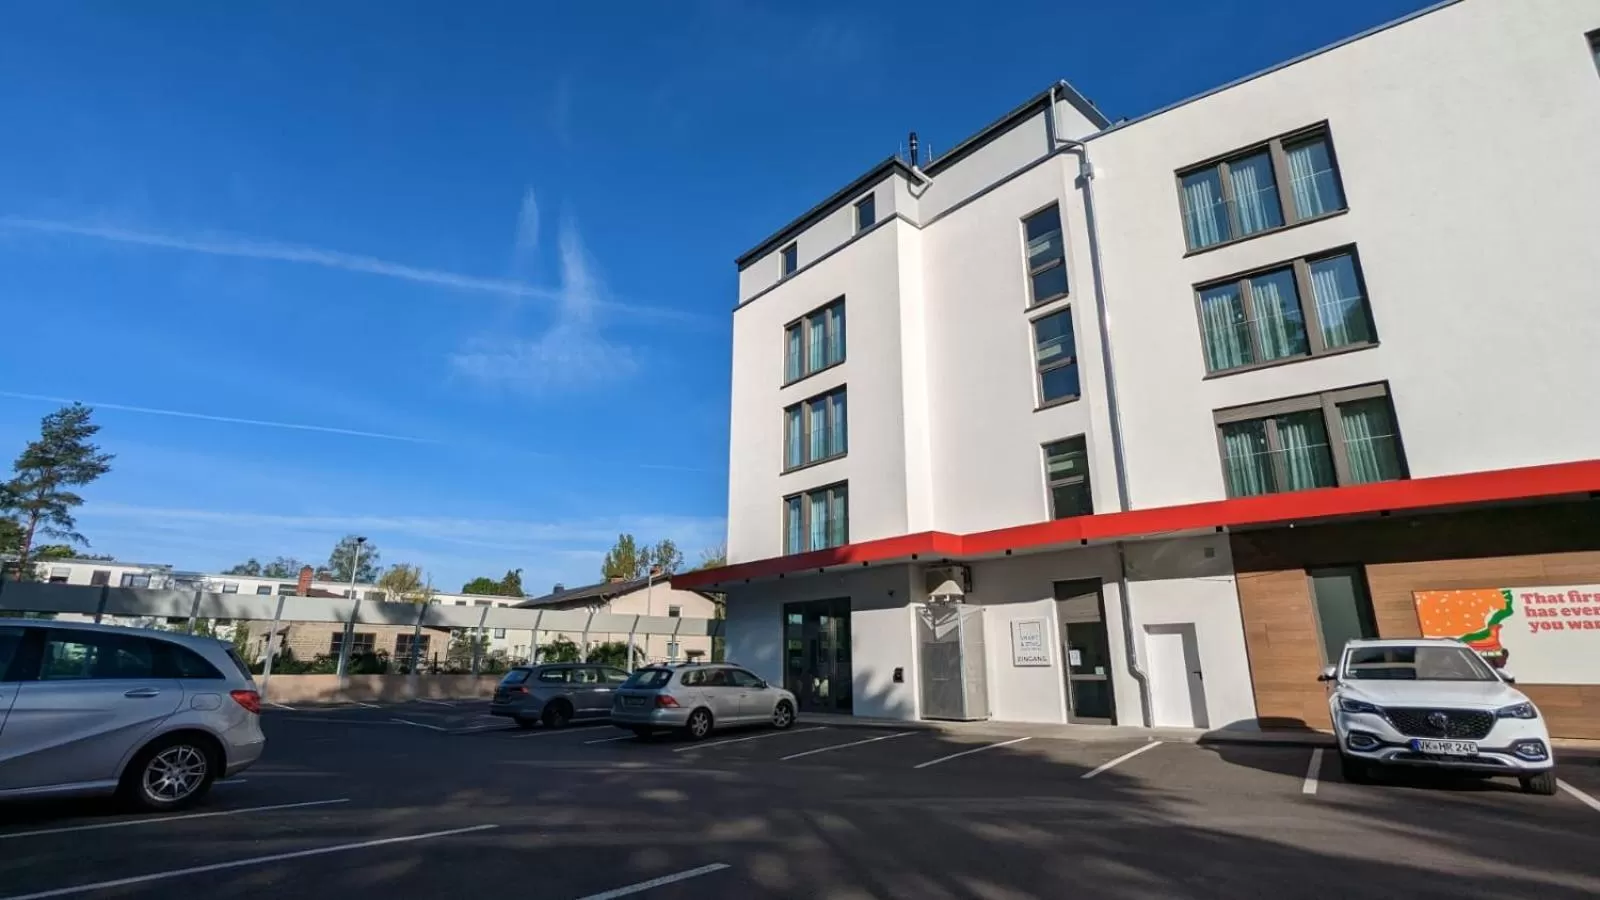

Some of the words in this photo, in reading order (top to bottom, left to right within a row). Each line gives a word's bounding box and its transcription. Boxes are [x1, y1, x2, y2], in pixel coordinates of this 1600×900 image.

[1520, 592, 1565, 604] That
[1524, 606, 1558, 617] has
[1528, 621, 1564, 633] you
